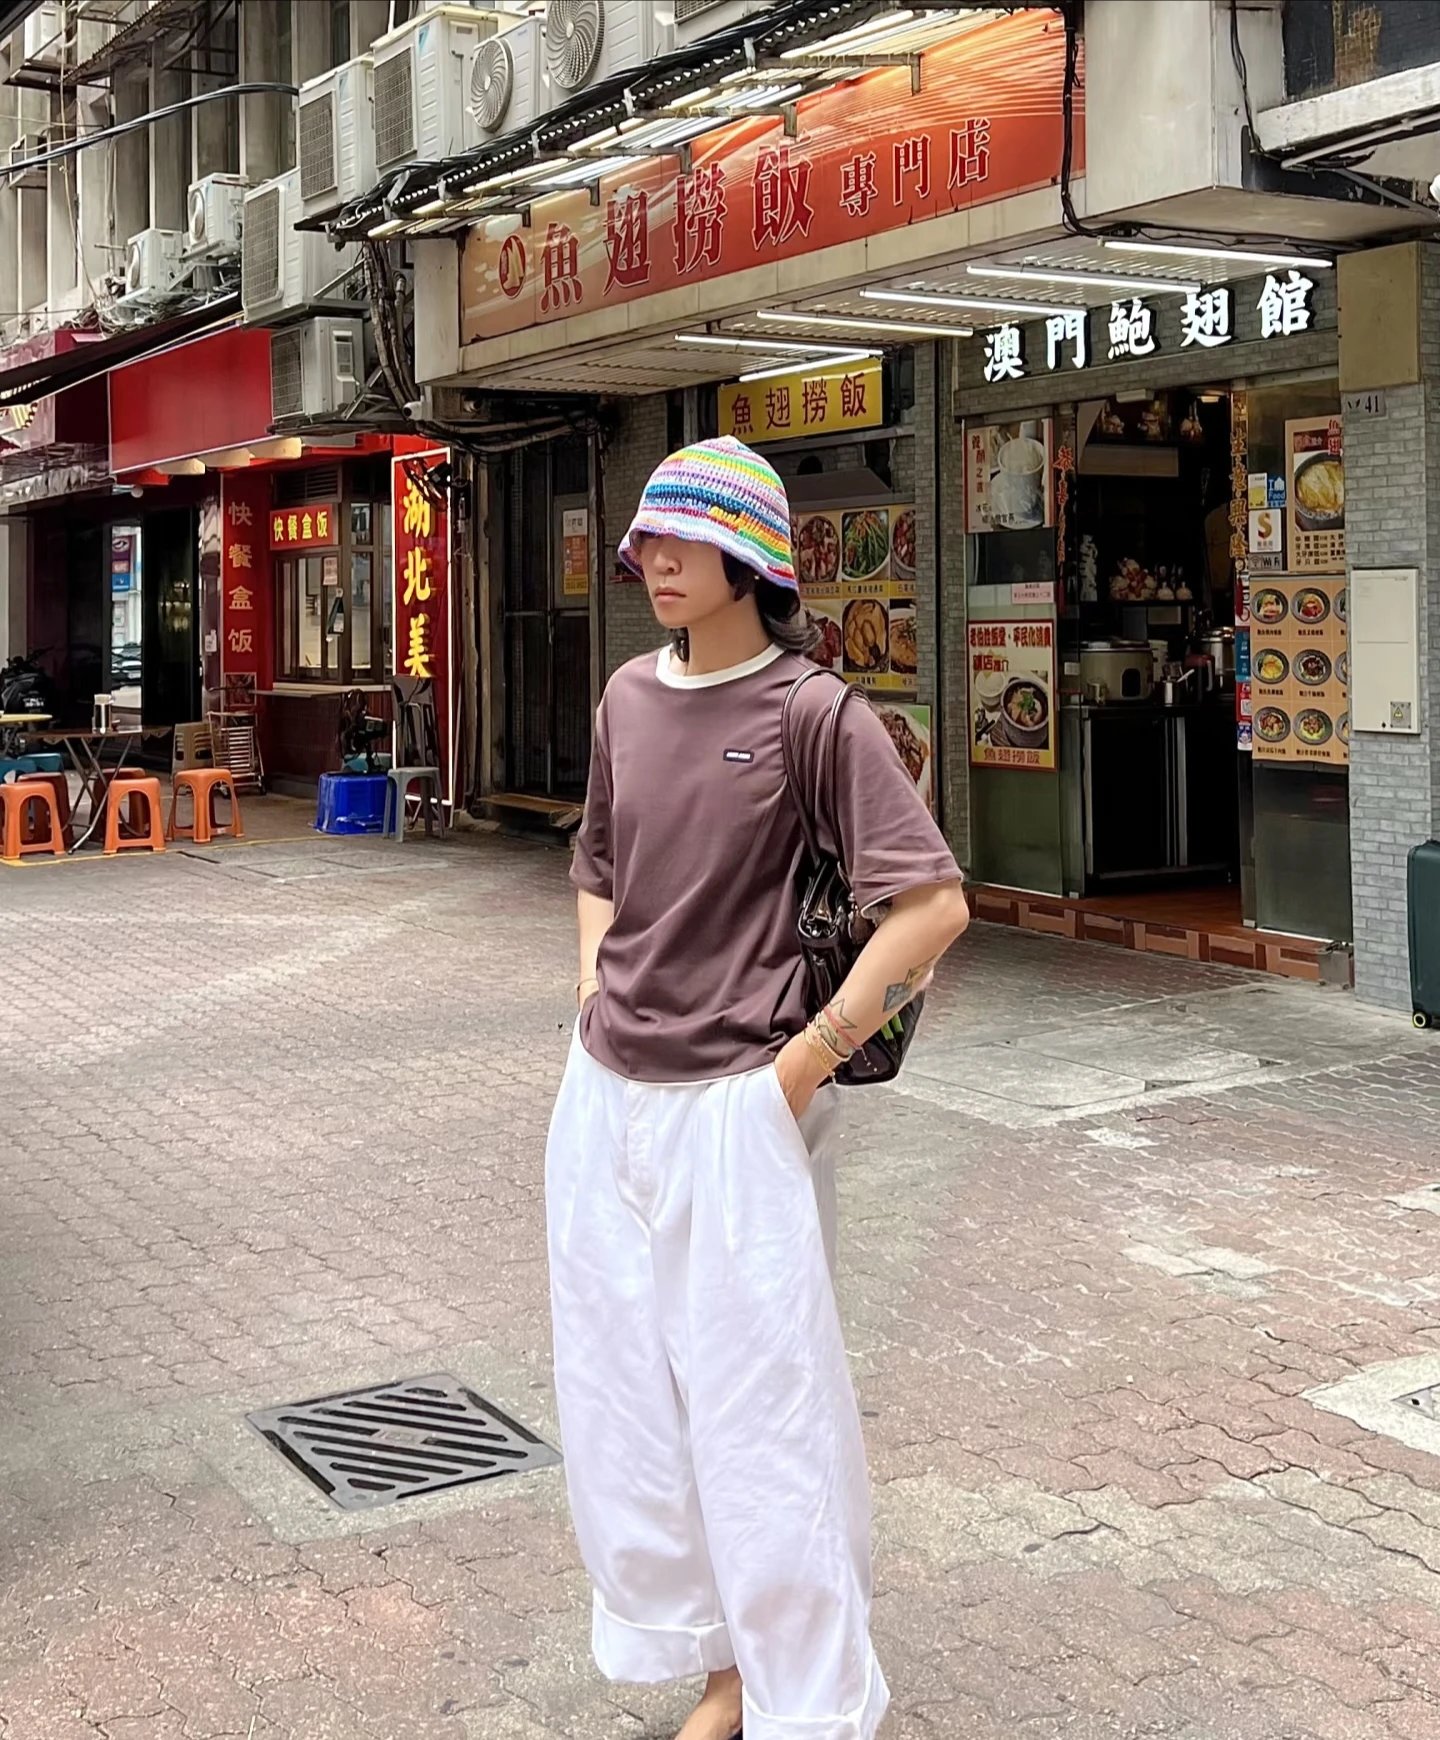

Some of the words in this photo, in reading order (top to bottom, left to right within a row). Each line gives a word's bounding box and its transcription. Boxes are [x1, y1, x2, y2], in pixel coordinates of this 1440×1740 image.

[982, 270, 1315, 383] 澳門鮑翅館
[731, 373, 867, 436] 魚翅撈飯
[273, 511, 328, 542] 快餐盒饭
[228, 501, 253, 653] 快餐盒饭
